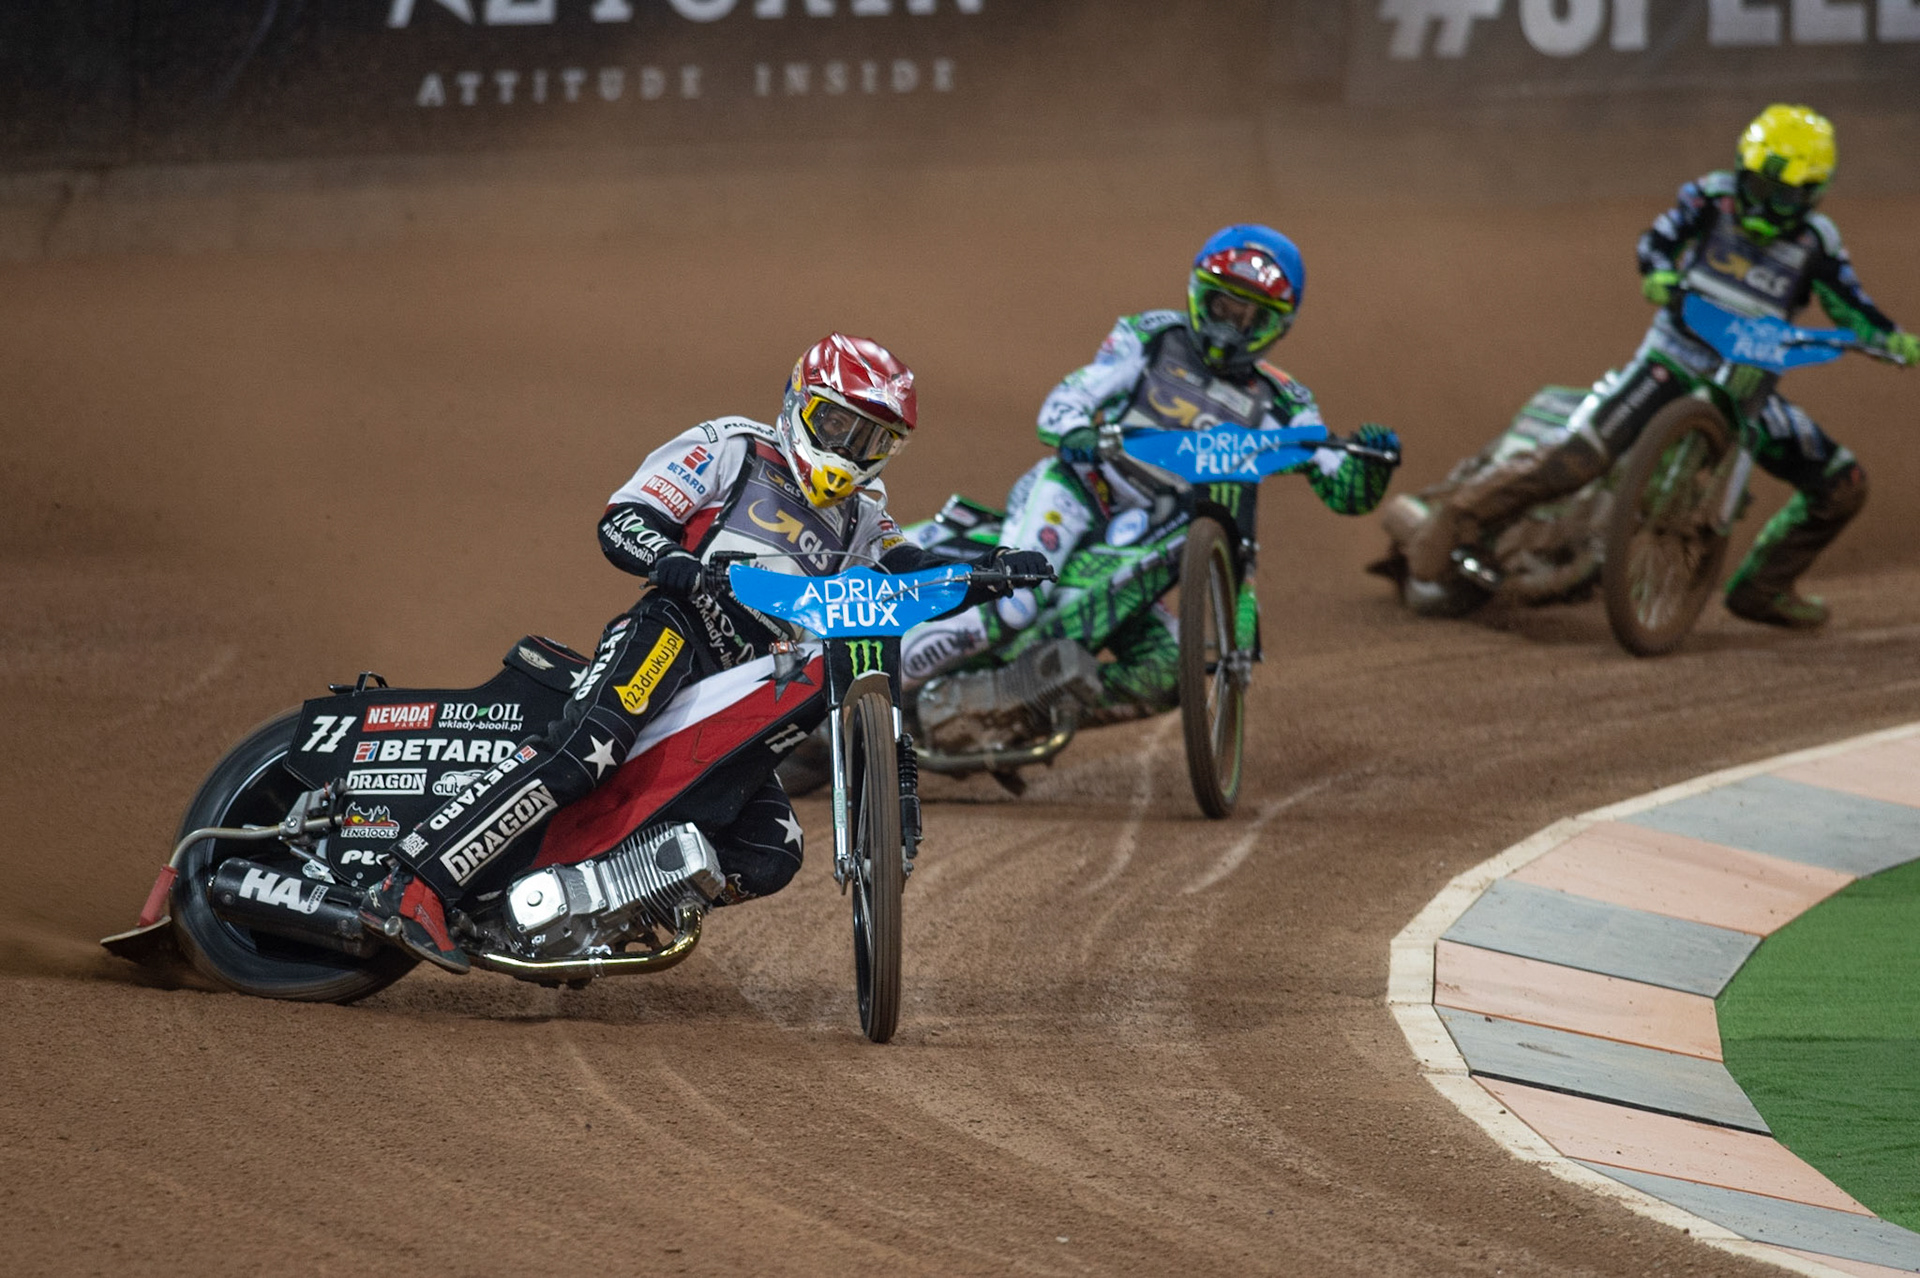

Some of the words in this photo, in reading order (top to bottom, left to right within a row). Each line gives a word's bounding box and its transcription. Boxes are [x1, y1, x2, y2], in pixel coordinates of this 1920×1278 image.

[416, 67, 702, 107] ATTITUDE
[755, 59, 956, 96] INSIDE
[1176, 433, 1280, 457] ADRIAN
[1195, 453, 1259, 476] FLUX
[667, 462, 706, 495] BETARD
[783, 483, 801, 498] GLS
[645, 476, 690, 514] NEVADA
[799, 530, 833, 571] GLS
[803, 578, 919, 605] ADRIAN
[827, 602, 900, 629] FLUX
[575, 631, 627, 701] BETARD
[624, 631, 681, 709] 123drukuj.pl
[367, 706, 430, 725] NEVADA
[394, 721, 429, 729] PARTS
[438, 720, 522, 732] wklady-biooil.pl
[301, 715, 357, 752] 71
[378, 738, 518, 764] BETARD
[348, 774, 425, 790] DRAGON
[429, 758, 518, 831] BETARD
[449, 785, 552, 882] DRAGON
